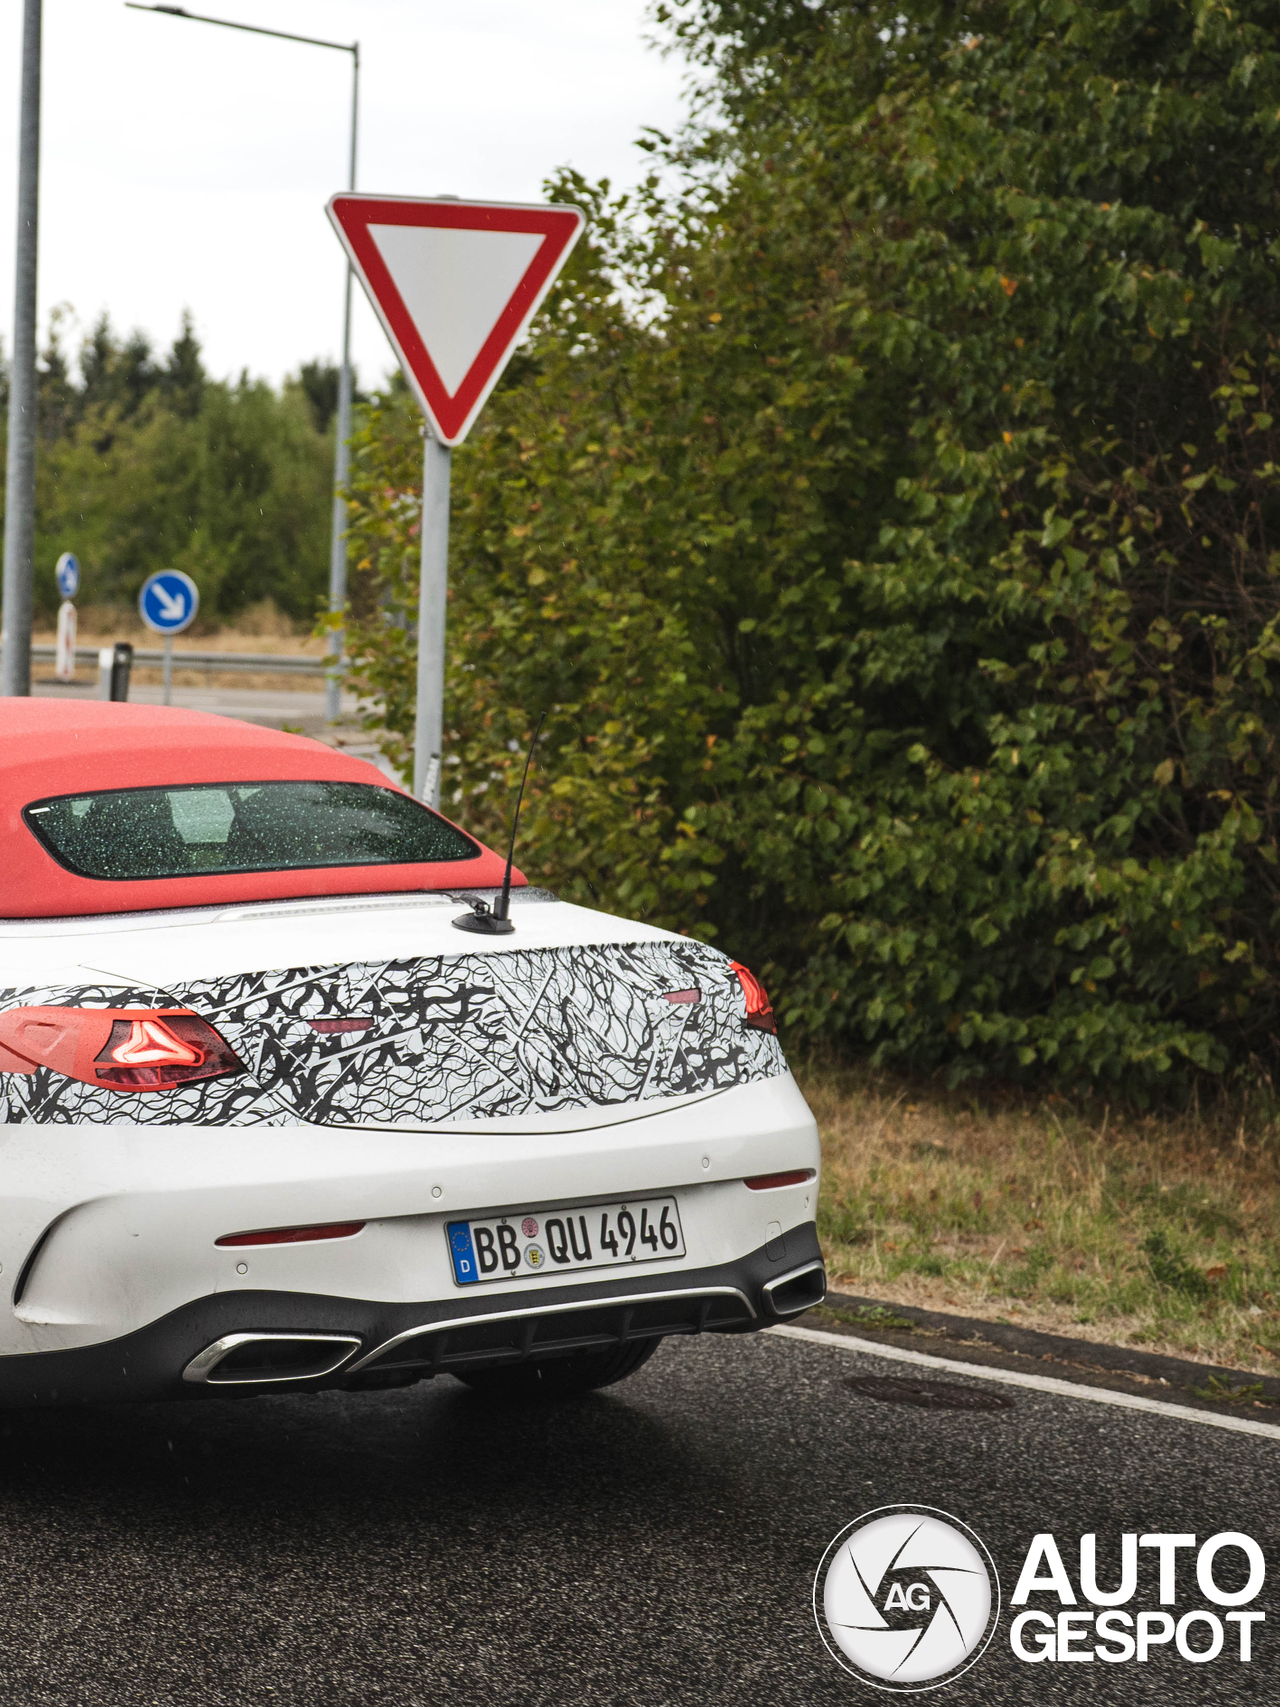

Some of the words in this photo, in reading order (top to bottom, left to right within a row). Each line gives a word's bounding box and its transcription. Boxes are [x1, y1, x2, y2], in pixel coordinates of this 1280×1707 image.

[474, 1224, 521, 1273] BB
[545, 1215, 592, 1263] QU
[600, 1206, 678, 1257] 4946
[460, 1259, 470, 1274] D
